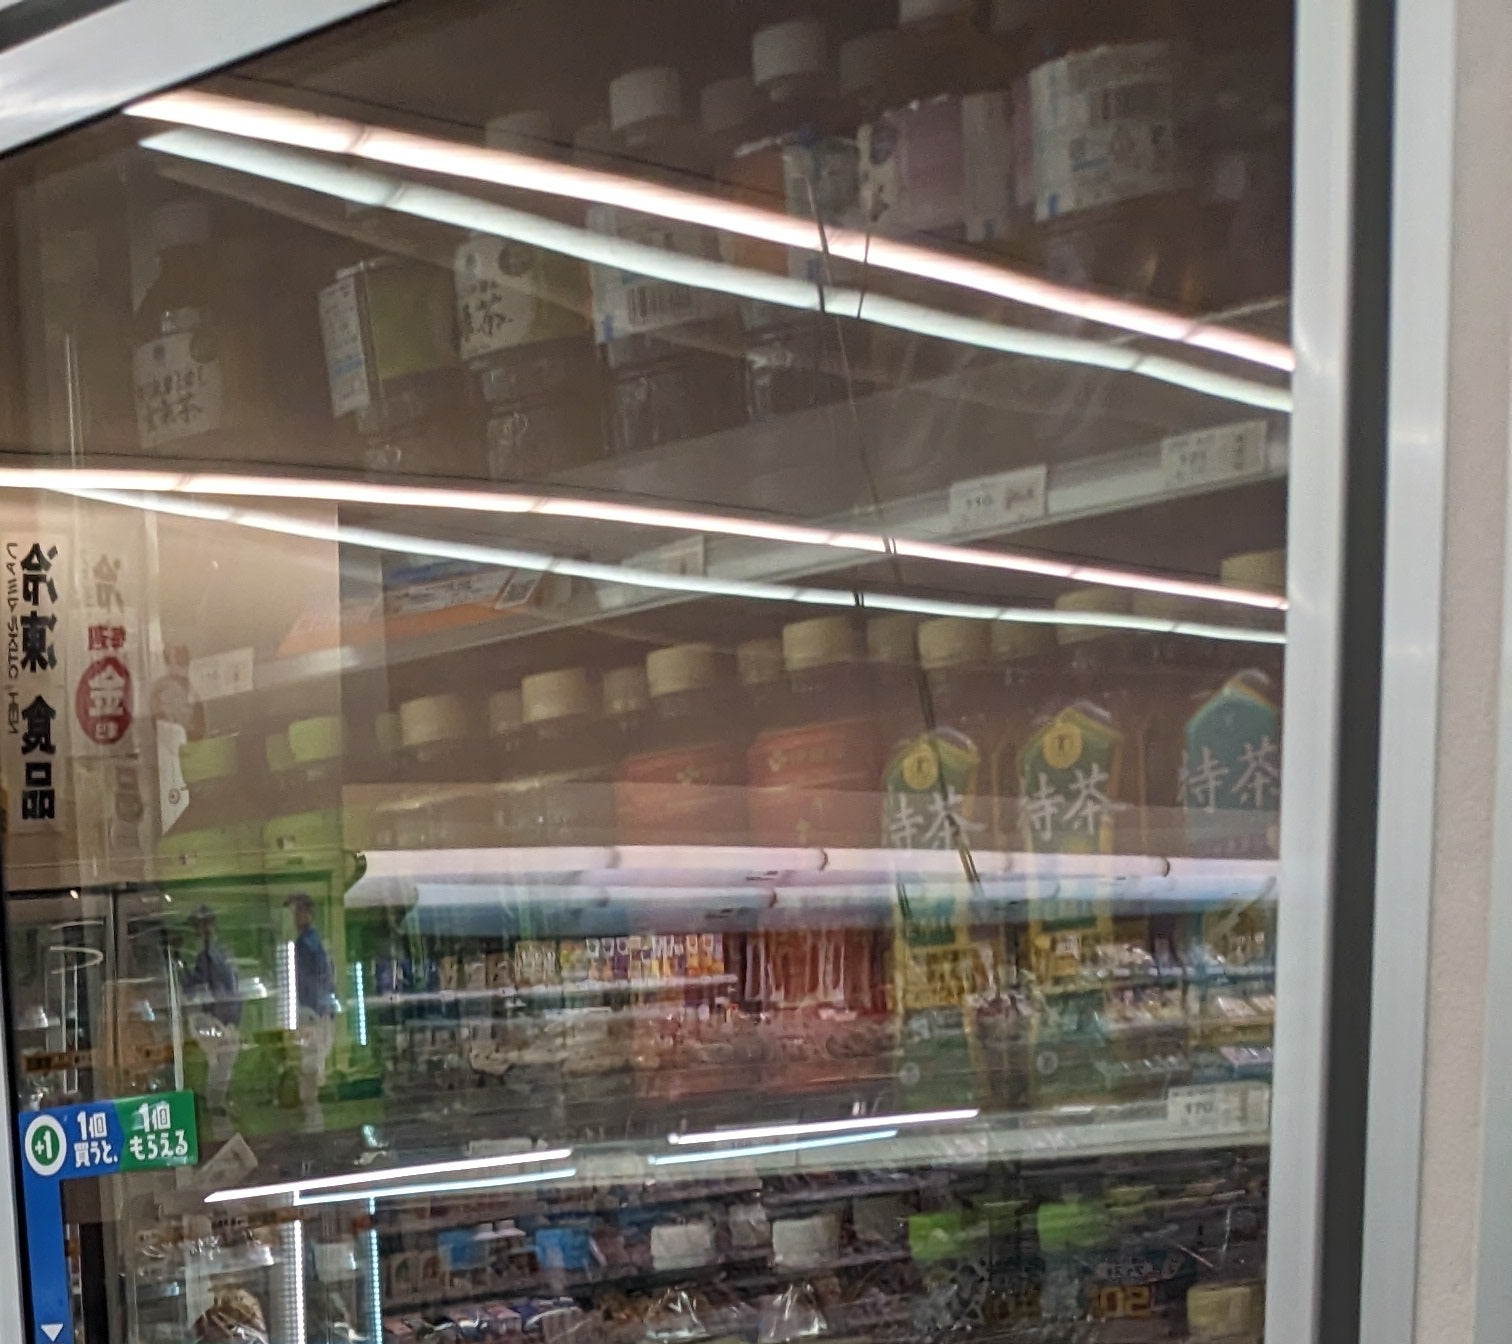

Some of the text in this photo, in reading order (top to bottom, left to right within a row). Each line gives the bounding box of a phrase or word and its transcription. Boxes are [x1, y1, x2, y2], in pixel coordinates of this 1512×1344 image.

[77, 1111, 107, 1140] 1個
[138, 1103, 171, 1132] 1個
[129, 1130, 188, 1160] もらえる
